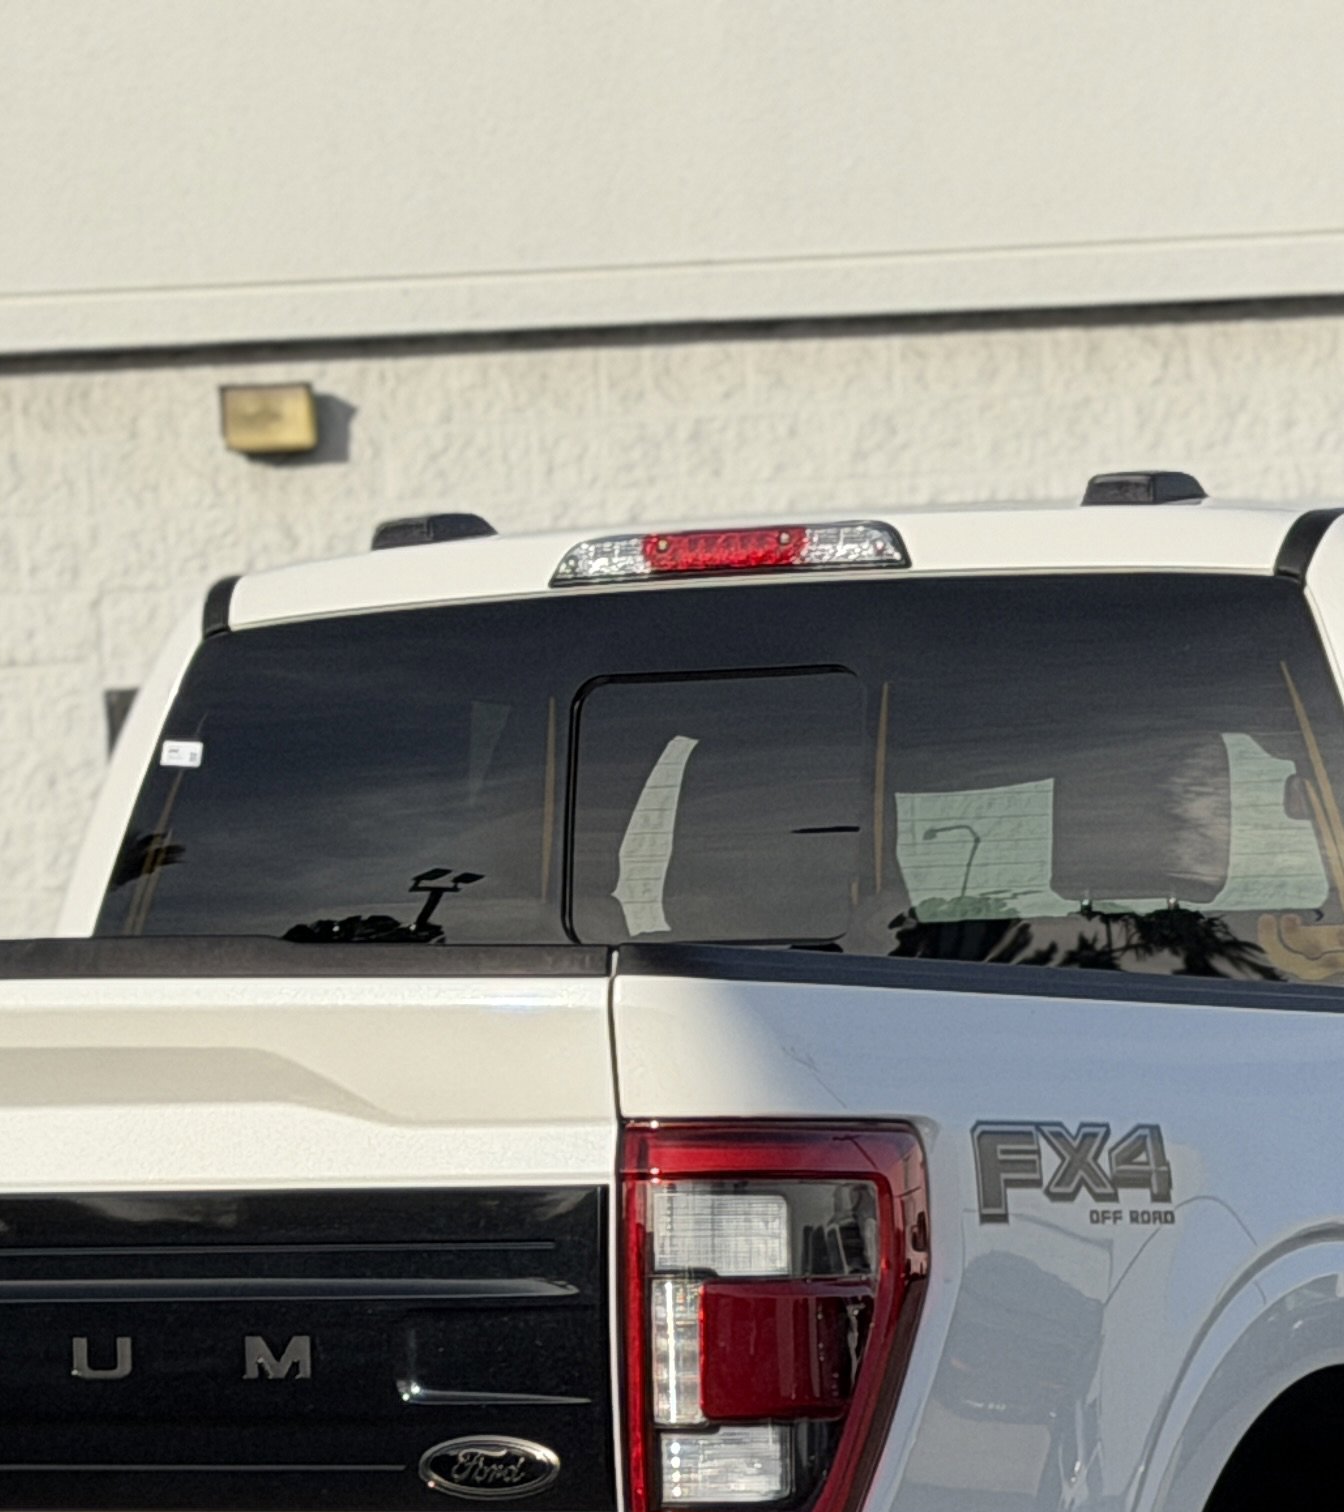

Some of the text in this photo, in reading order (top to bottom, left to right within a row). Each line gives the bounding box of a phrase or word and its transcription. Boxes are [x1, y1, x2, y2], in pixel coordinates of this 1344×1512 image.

[970, 1120, 1173, 1225] FX4
[1089, 1210, 1176, 1225] OFF ROAD
[451, 1448, 525, 1483] Ford
